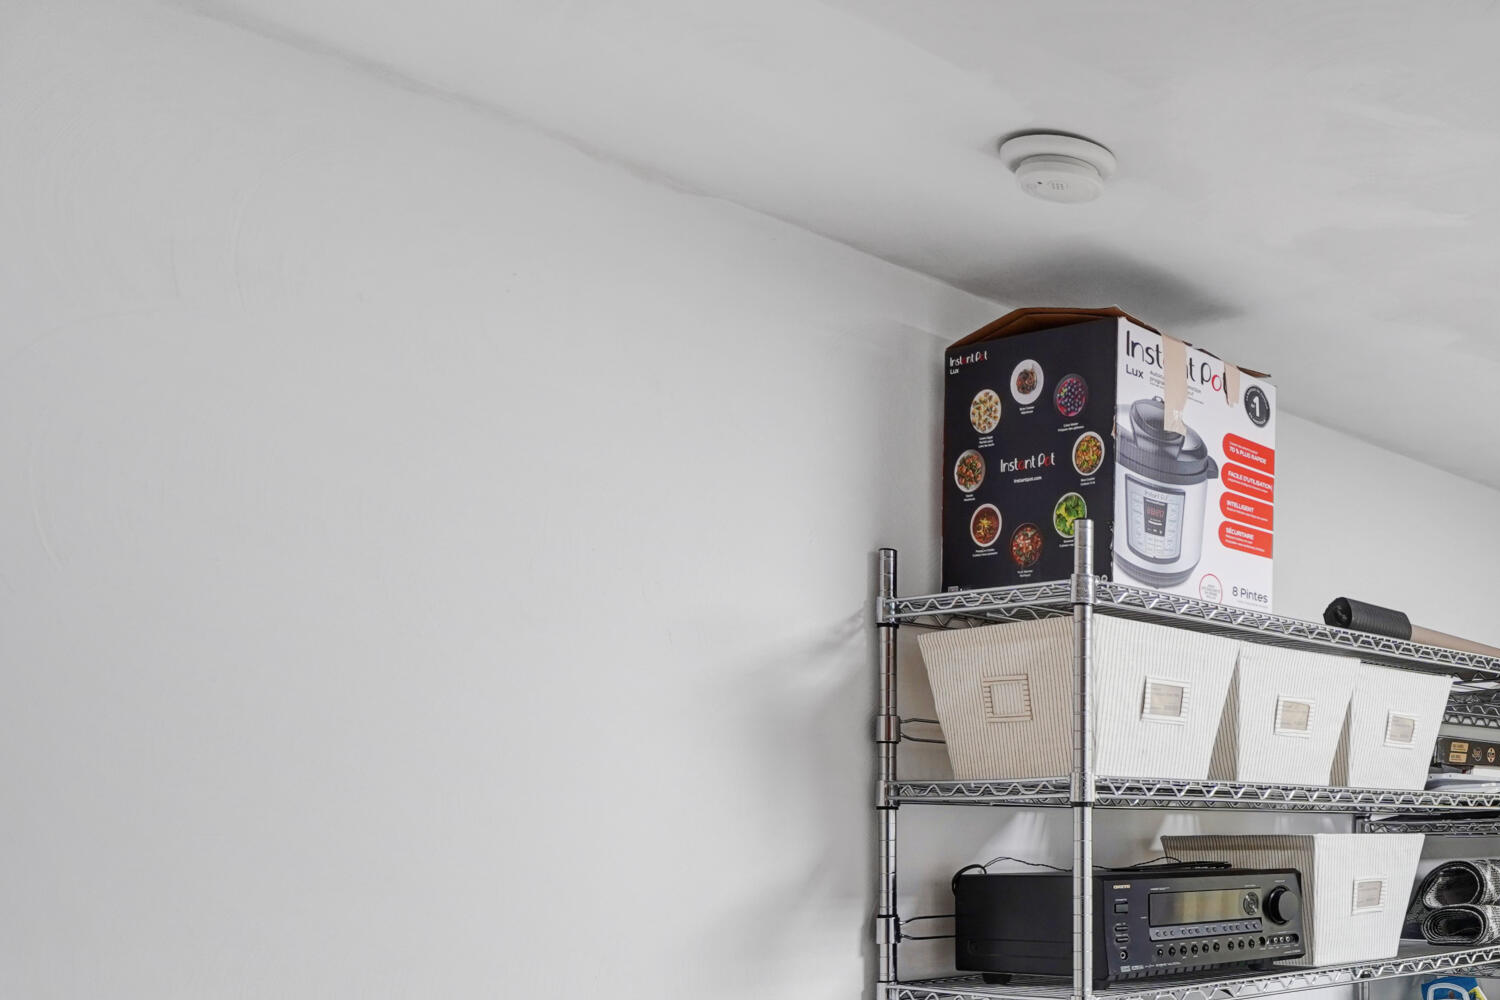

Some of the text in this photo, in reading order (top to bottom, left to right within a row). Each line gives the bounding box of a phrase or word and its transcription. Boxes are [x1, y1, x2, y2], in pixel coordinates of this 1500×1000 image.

[950, 350, 987, 367] Instant Pot
[1126, 330, 1195, 382] Instt
[1125, 364, 1144, 379] Lux
[1000, 452, 1056, 473] Instant Pot
[1232, 586, 1239, 597] 8
[1240, 587, 1268, 604] Pintes
